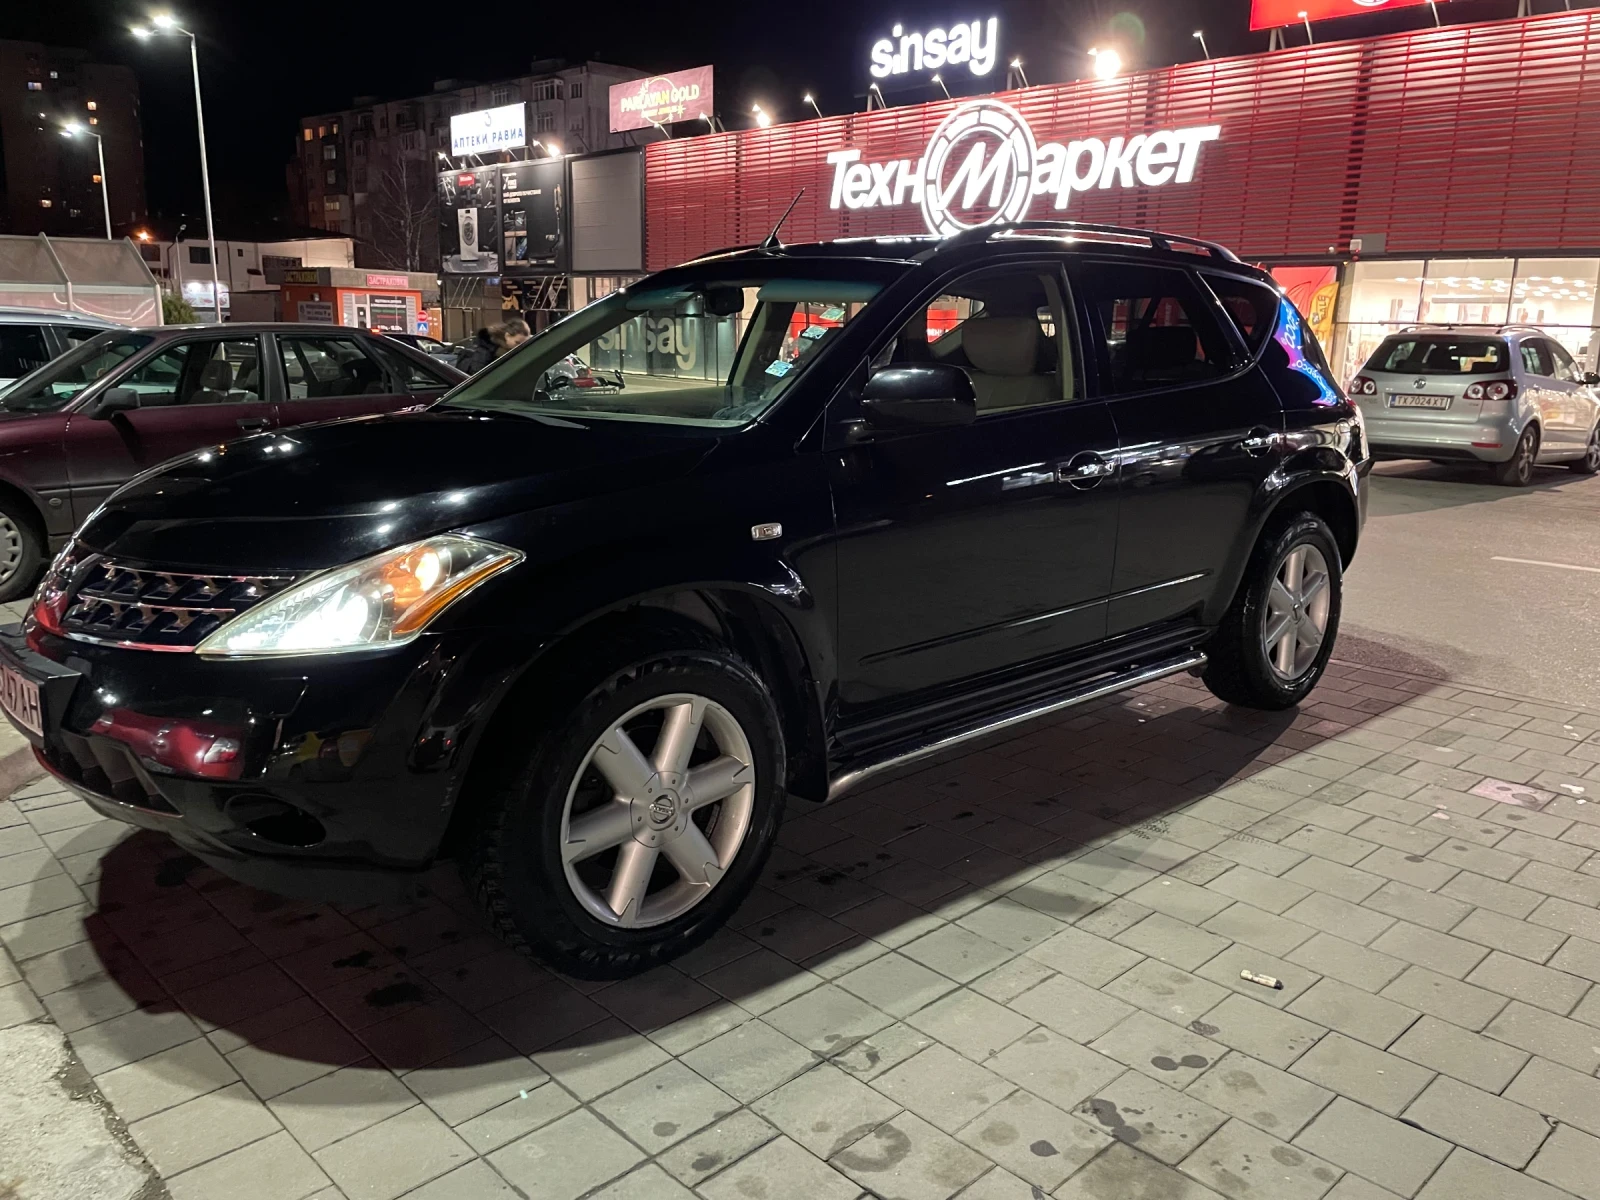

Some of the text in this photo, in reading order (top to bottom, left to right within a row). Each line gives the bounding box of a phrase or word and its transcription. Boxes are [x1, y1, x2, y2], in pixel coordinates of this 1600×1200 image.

[870, 16, 999, 77] sinsay
[670, 84, 700, 103] GOLD
[454, 127, 524, 149] АПТЕКИ РАВИА
[368, 275, 407, 286] ЗАСТРАХОВКИ
[1396, 395, 1445, 407] TX 7024 XT
[20, 683, 41, 729] AH
